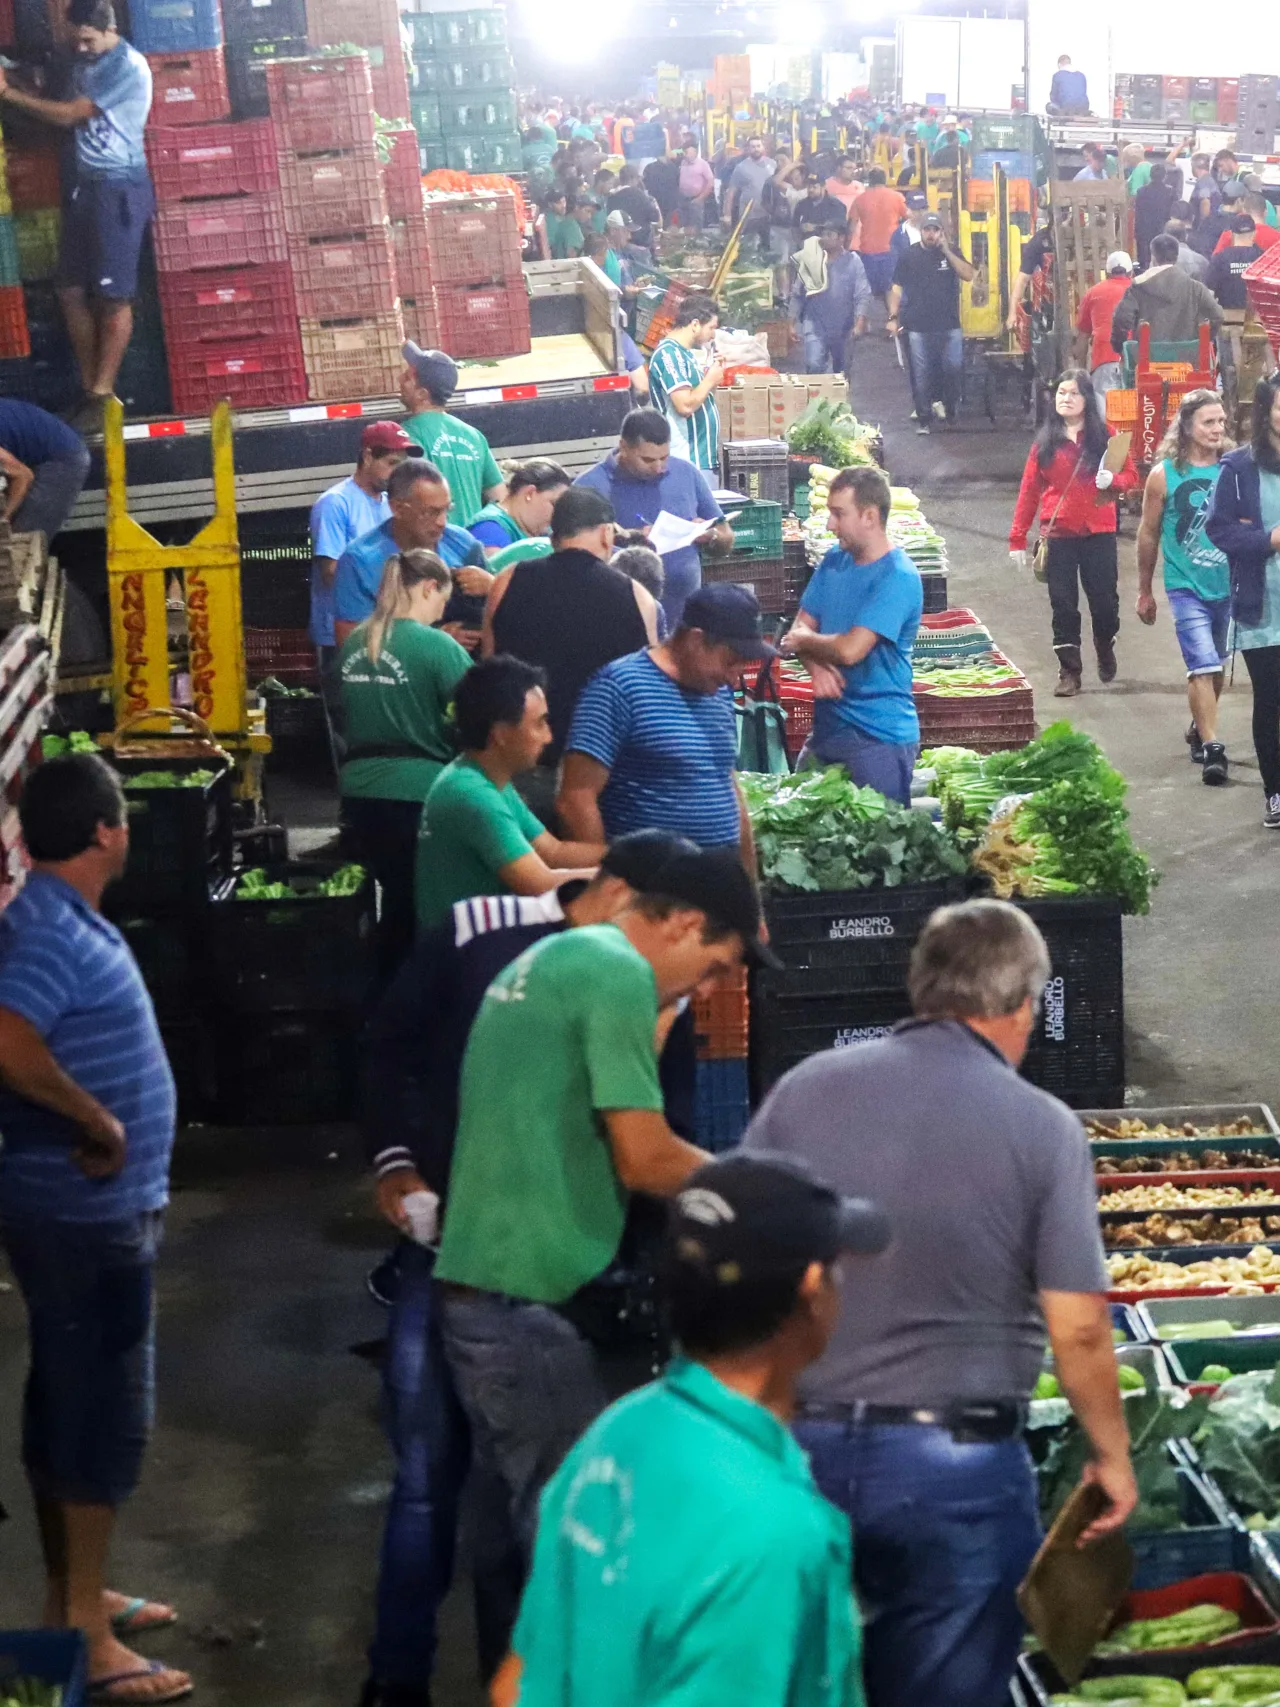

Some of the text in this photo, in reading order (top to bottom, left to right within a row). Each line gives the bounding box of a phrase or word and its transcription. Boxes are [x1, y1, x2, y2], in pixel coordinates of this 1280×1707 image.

[831, 916, 891, 929] LEANDRO
[829, 925, 895, 939] BURBELLO
[1044, 980, 1055, 1038] LEANDRO
[1054, 976, 1065, 1041] BURBELLO
[836, 1025, 893, 1039] LEANDRO
